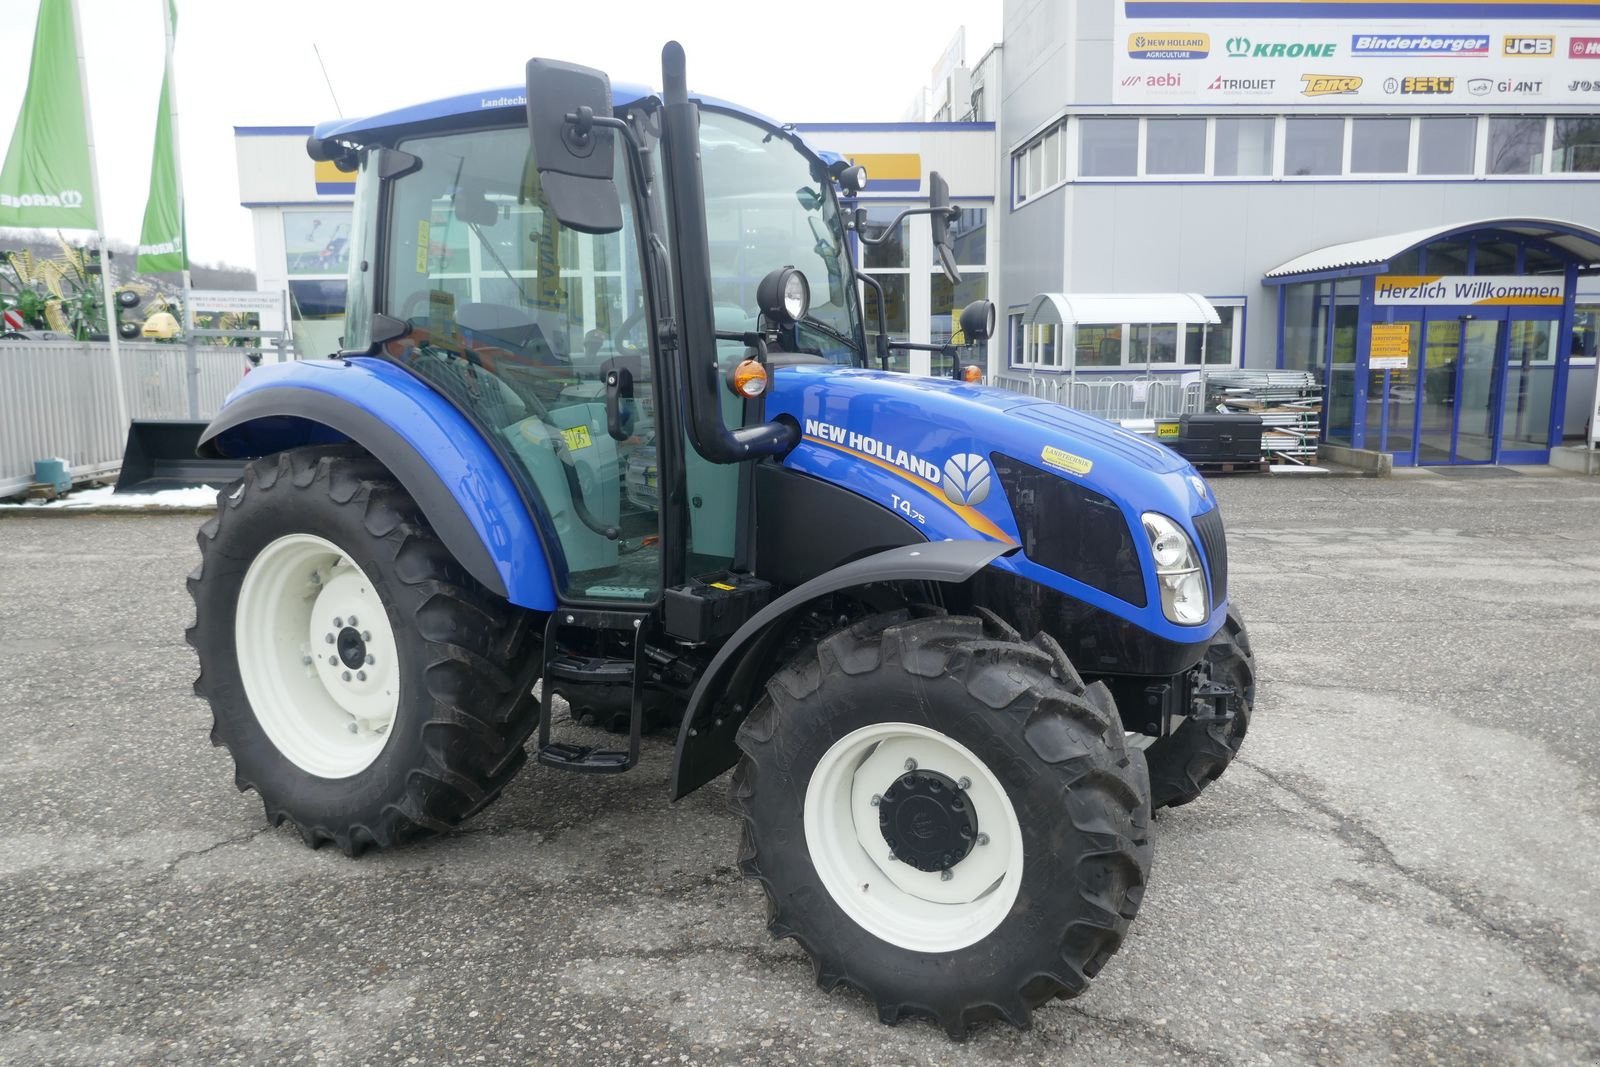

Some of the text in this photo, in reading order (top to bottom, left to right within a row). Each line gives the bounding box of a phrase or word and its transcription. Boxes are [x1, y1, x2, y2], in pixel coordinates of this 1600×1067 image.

[1147, 39, 1204, 47] NEW HOLLAND
[1252, 43, 1337, 57] KRONE
[1355, 36, 1487, 51] Binderberger
[1505, 39, 1552, 54] JCB
[1146, 73, 1182, 87] aebi
[1222, 79, 1275, 89] TRIOLIET
[1300, 74, 1363, 97] Tanco
[1379, 281, 1560, 299] Herzlich Willkommen
[805, 418, 941, 483] NEW HOLLAND
